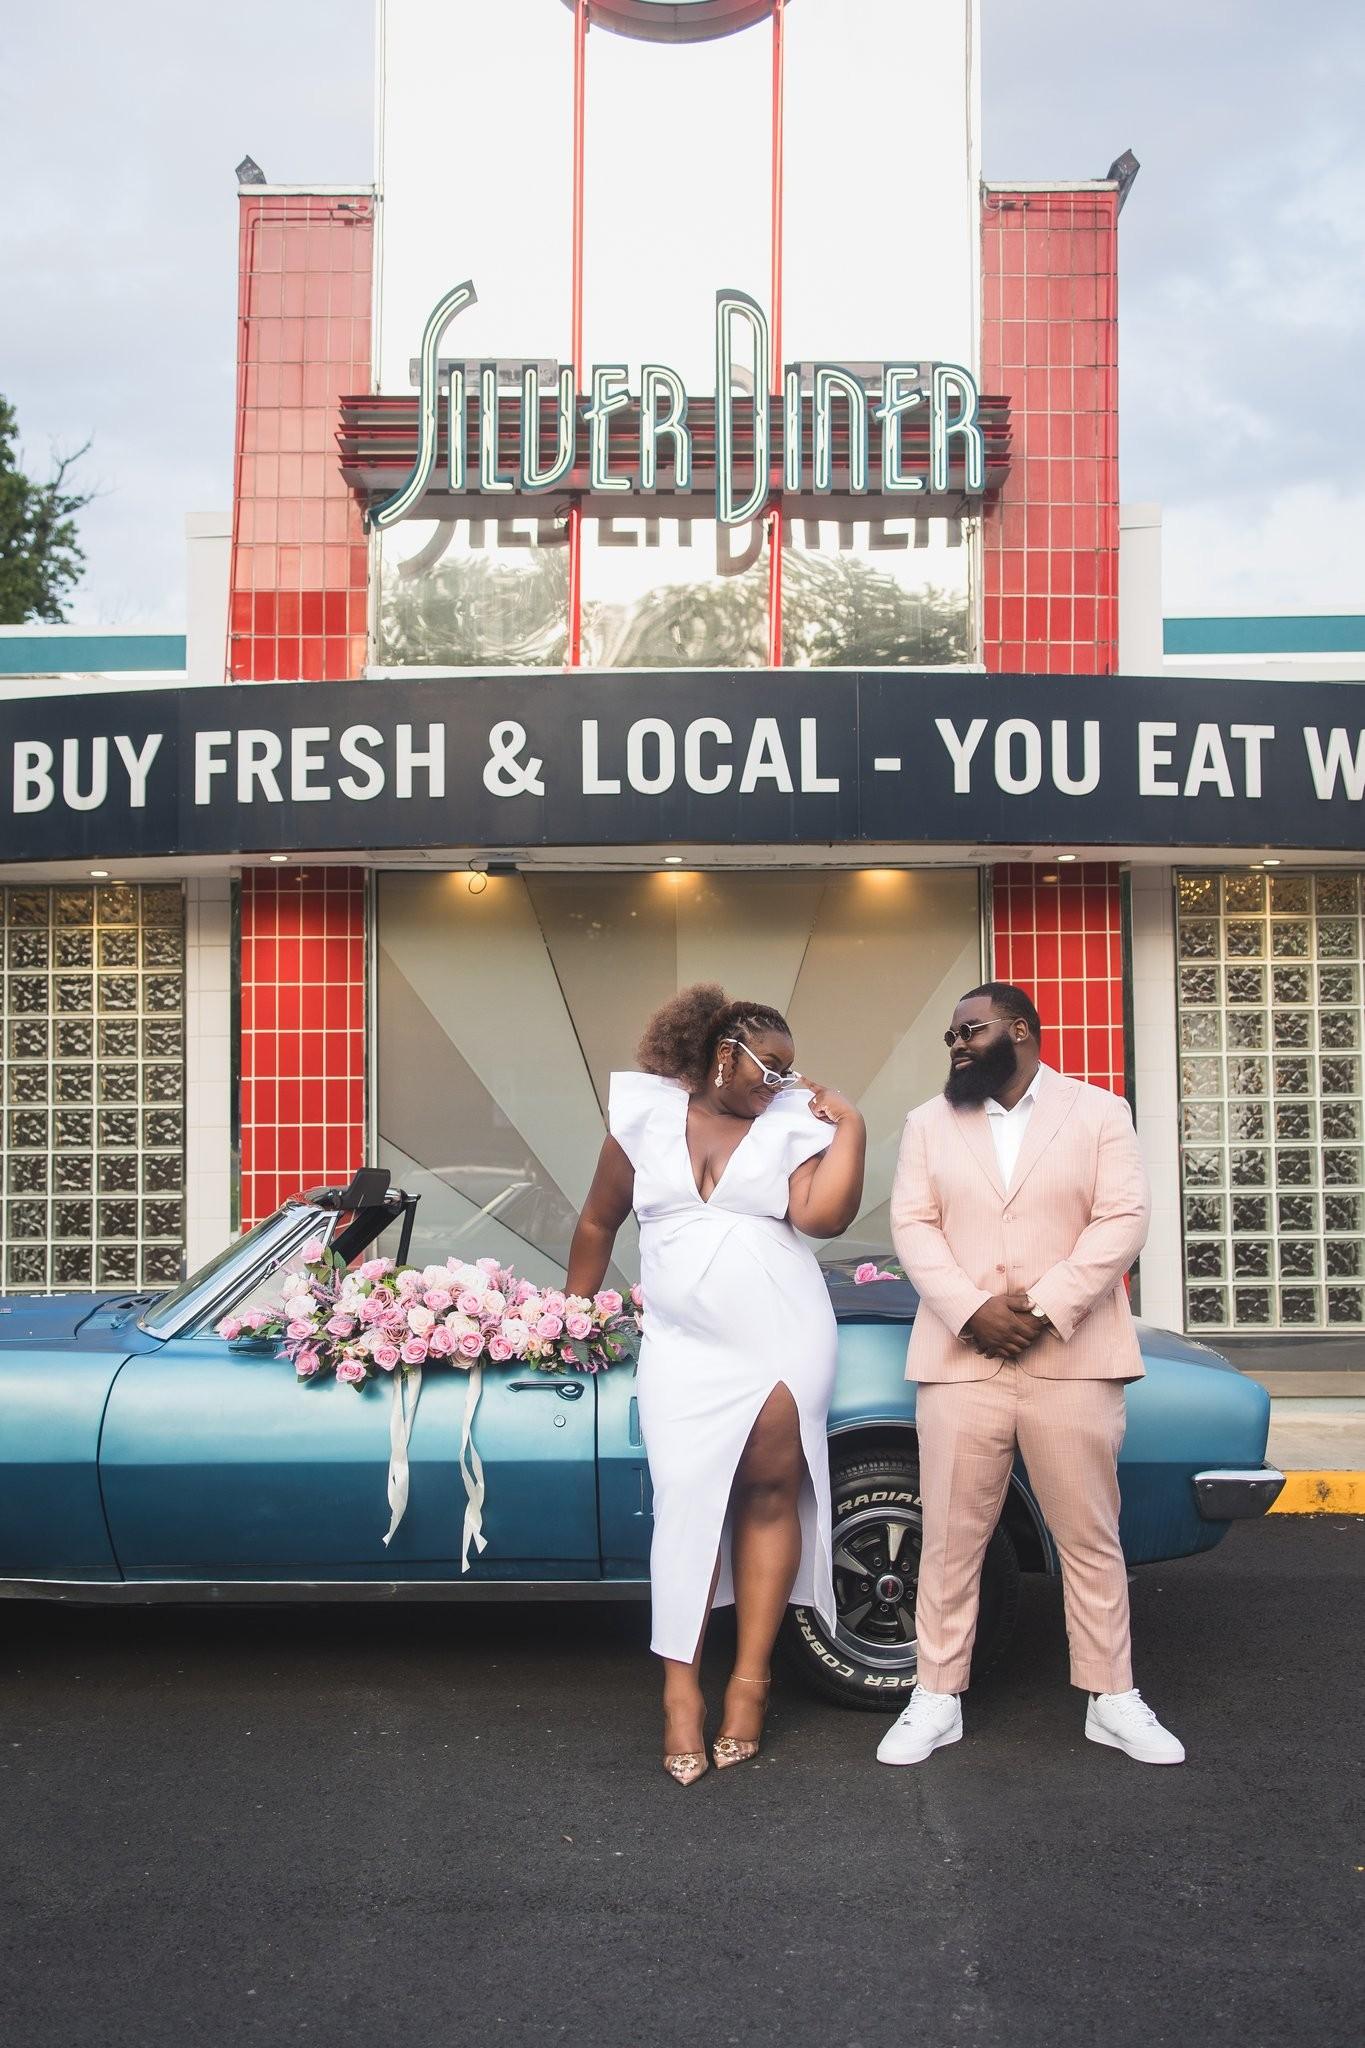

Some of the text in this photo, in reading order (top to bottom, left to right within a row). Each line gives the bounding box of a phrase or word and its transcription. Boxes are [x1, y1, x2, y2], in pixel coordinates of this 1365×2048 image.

[368, 279, 984, 529] SILVER DINER
[13, 733, 163, 813] BUY
[194, 723, 445, 805] FRESH
[482, 720, 545, 797] &
[581, 717, 840, 795] LOCAL
[935, 718, 1101, 796] YOU
[1138, 721, 1275, 798] EAT
[1303, 726, 1365, 801] W
[795, 1608, 855, 1678] COBRA
